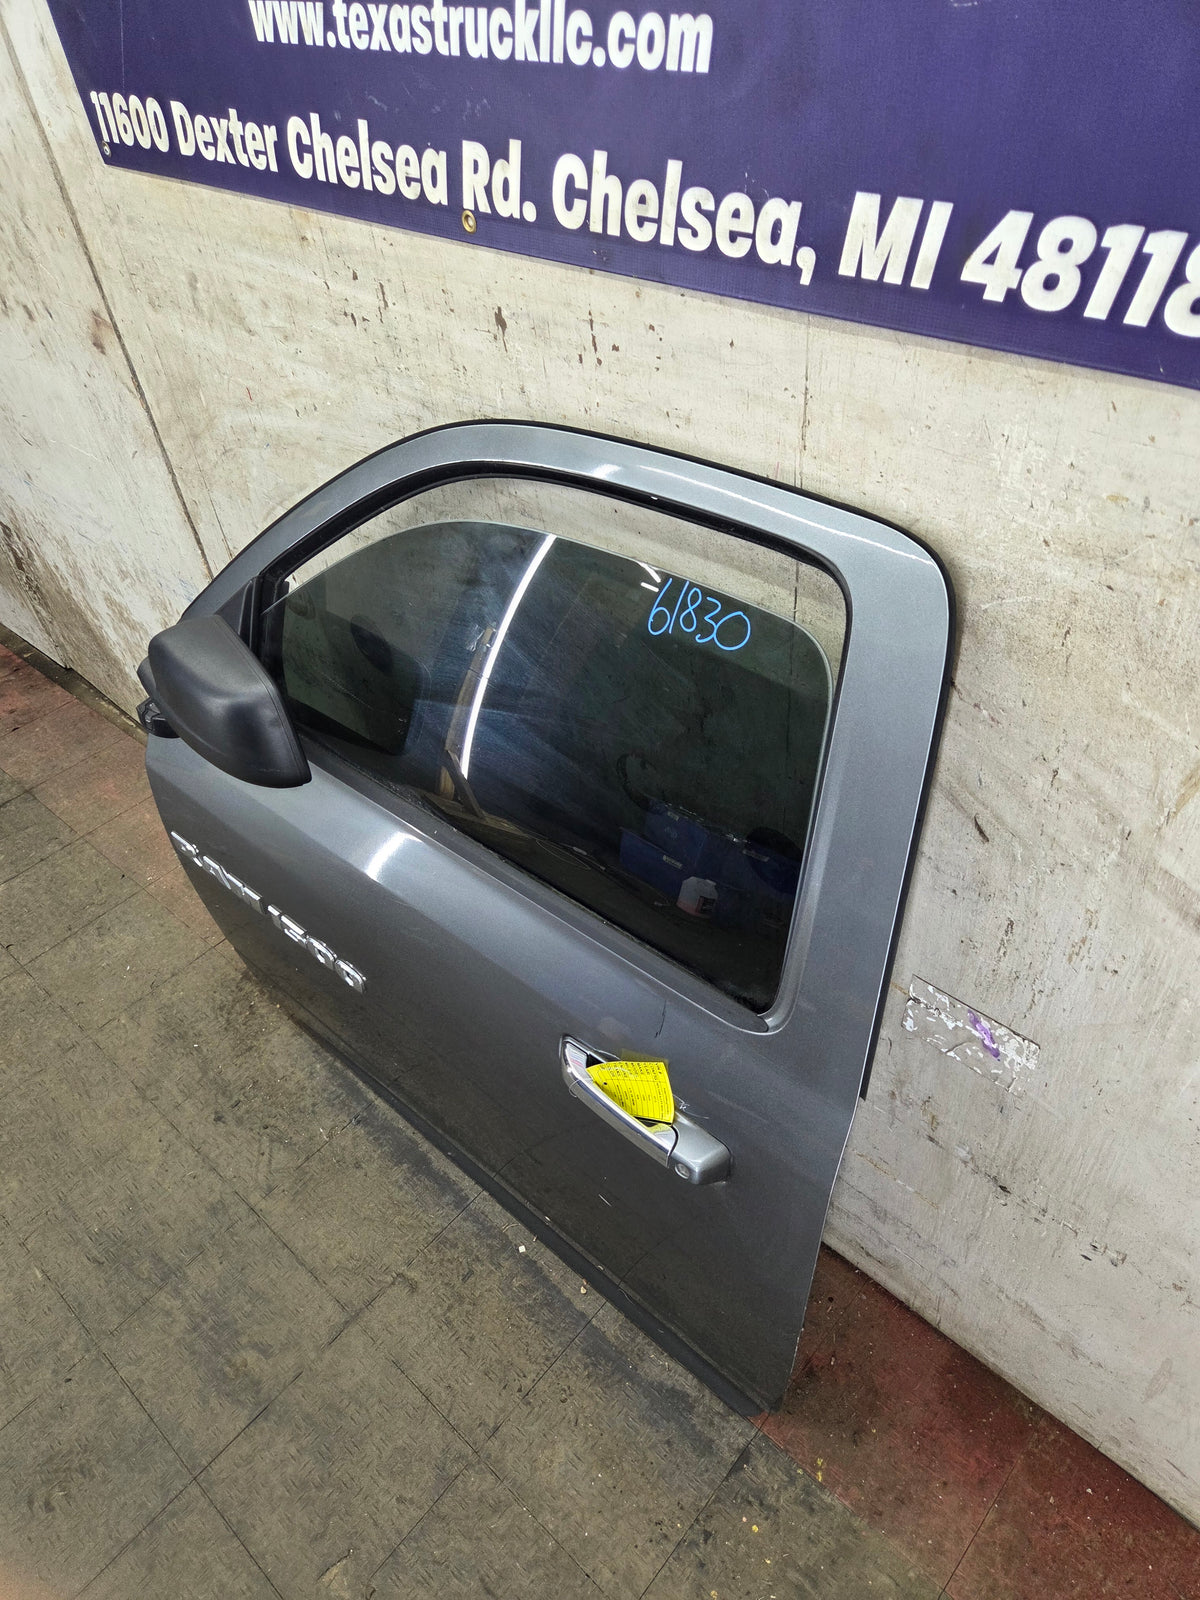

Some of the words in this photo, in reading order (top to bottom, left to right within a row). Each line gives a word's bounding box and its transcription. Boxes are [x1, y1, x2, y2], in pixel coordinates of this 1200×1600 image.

[248, 0, 714, 75] www.texastruckllc.com
[89, 90, 169, 153] 11600
[169, 100, 279, 173] Dexter
[286, 111, 449, 207] Chelsea
[462, 138, 537, 223] Rd.
[551, 146, 817, 287] Chelsea,
[837, 189, 955, 291] MI
[647, 577, 752, 651] 61830
